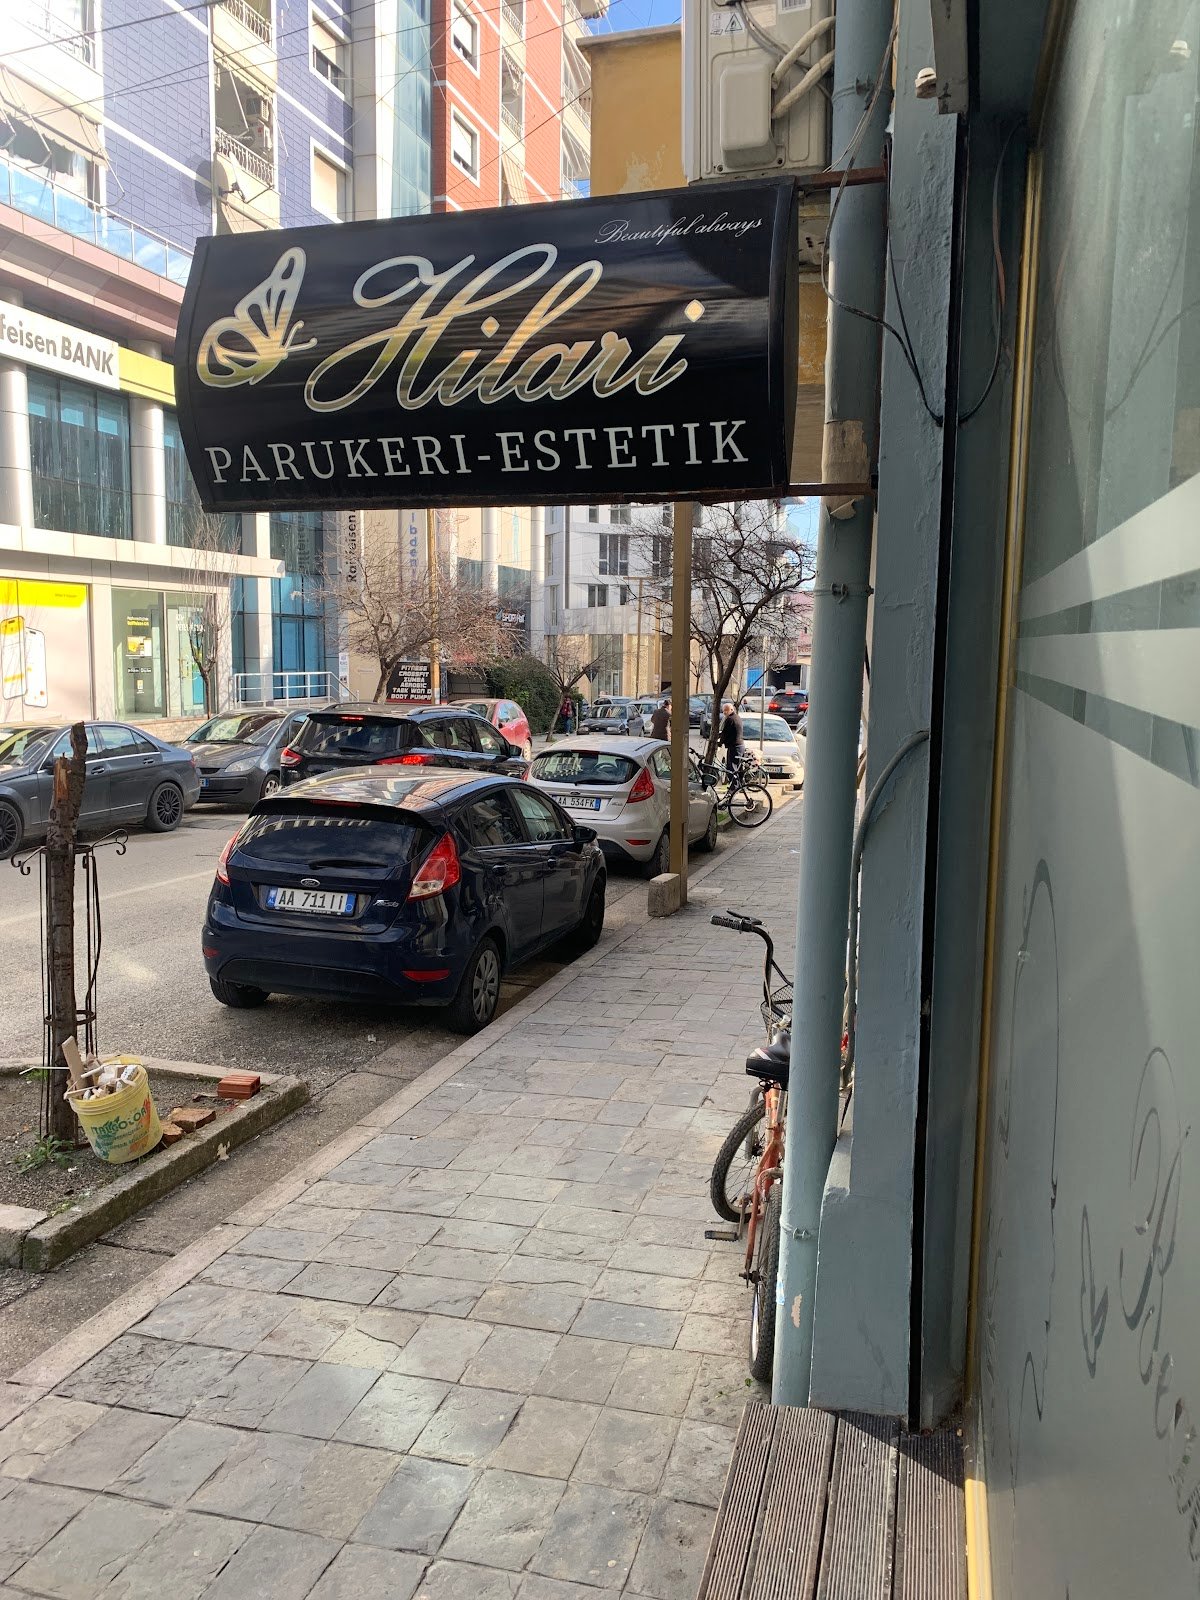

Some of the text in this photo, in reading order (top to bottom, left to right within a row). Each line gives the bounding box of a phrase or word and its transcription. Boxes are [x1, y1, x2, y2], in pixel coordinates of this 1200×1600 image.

[595, 212, 762, 245] Beautiful always
[304, 243, 705, 412] Hilari
[61, 336, 113, 376] BANK
[204, 420, 749, 484] PARUKERI-ESTETIK
[278, 890, 294, 906] AA
